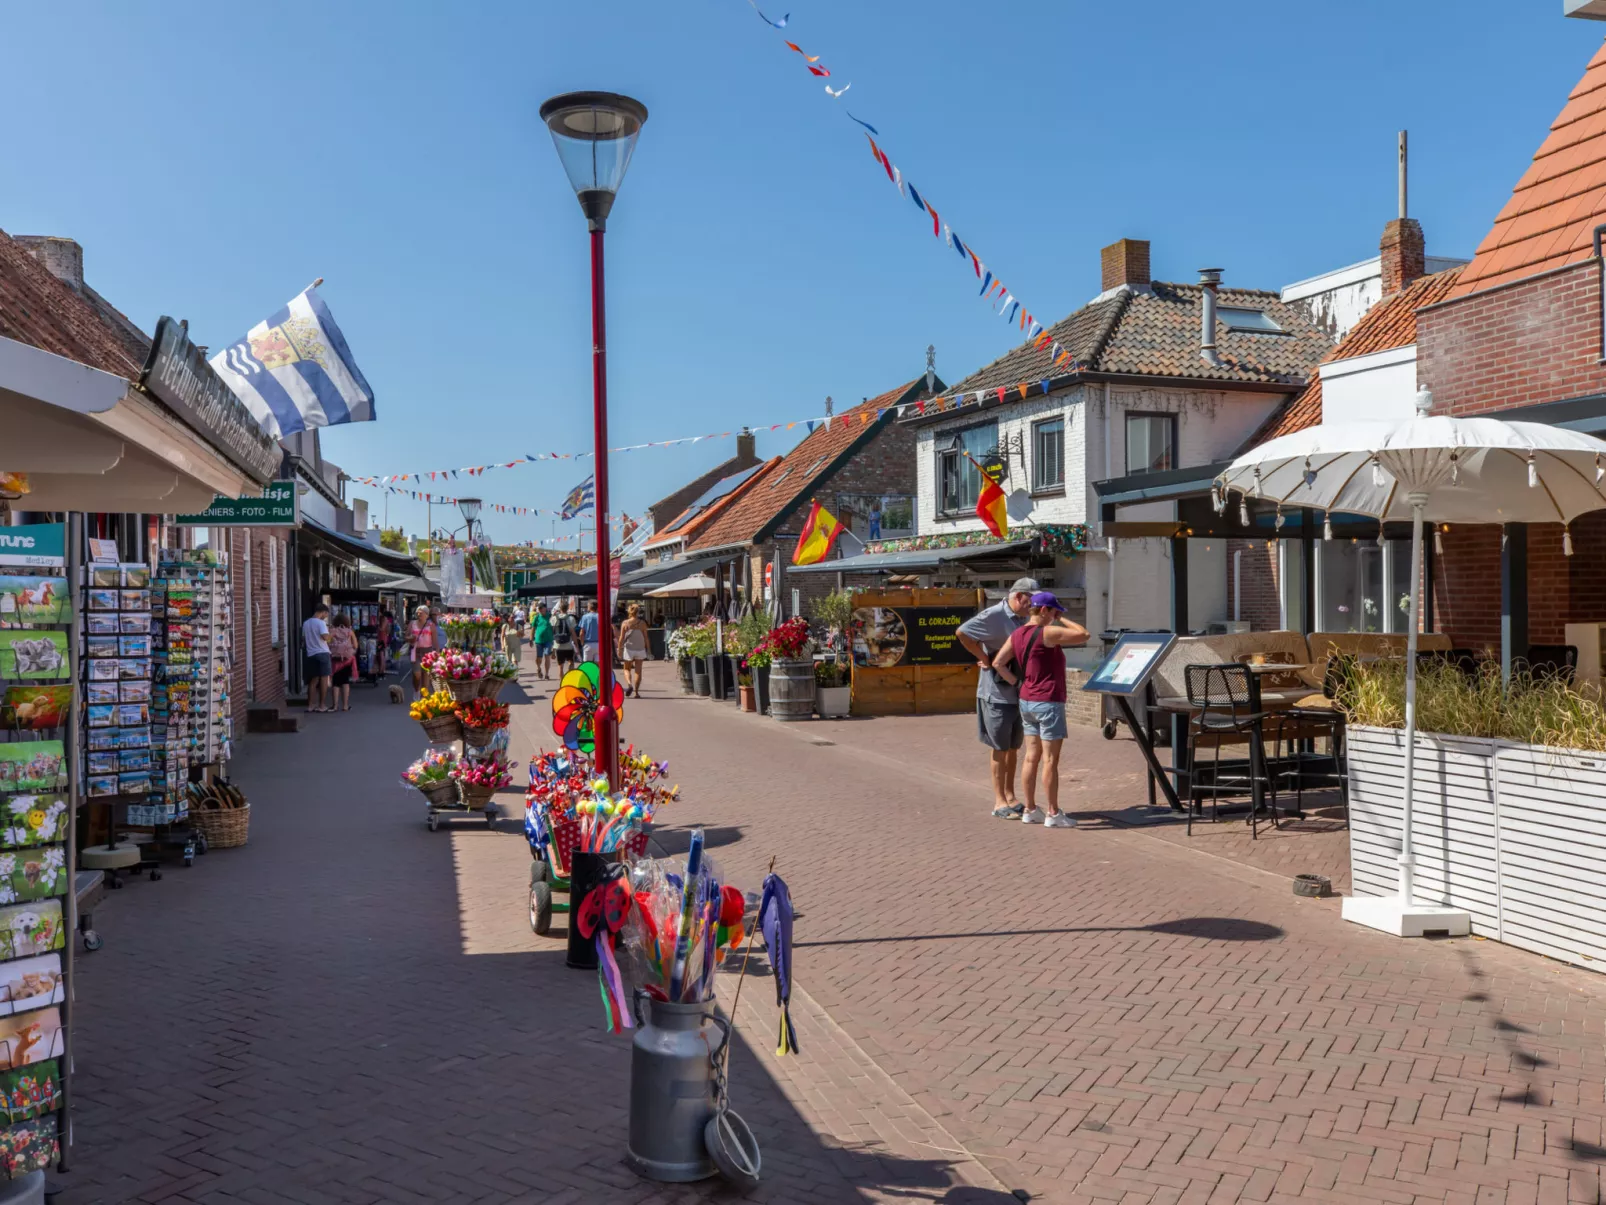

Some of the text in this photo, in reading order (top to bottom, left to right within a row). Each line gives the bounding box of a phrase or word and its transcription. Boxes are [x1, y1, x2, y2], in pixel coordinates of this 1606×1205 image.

[241, 507, 266, 516] FOTO
[272, 507, 293, 516] FILM
[25, 556, 55, 566] Medley
[918, 618, 928, 626] EL
